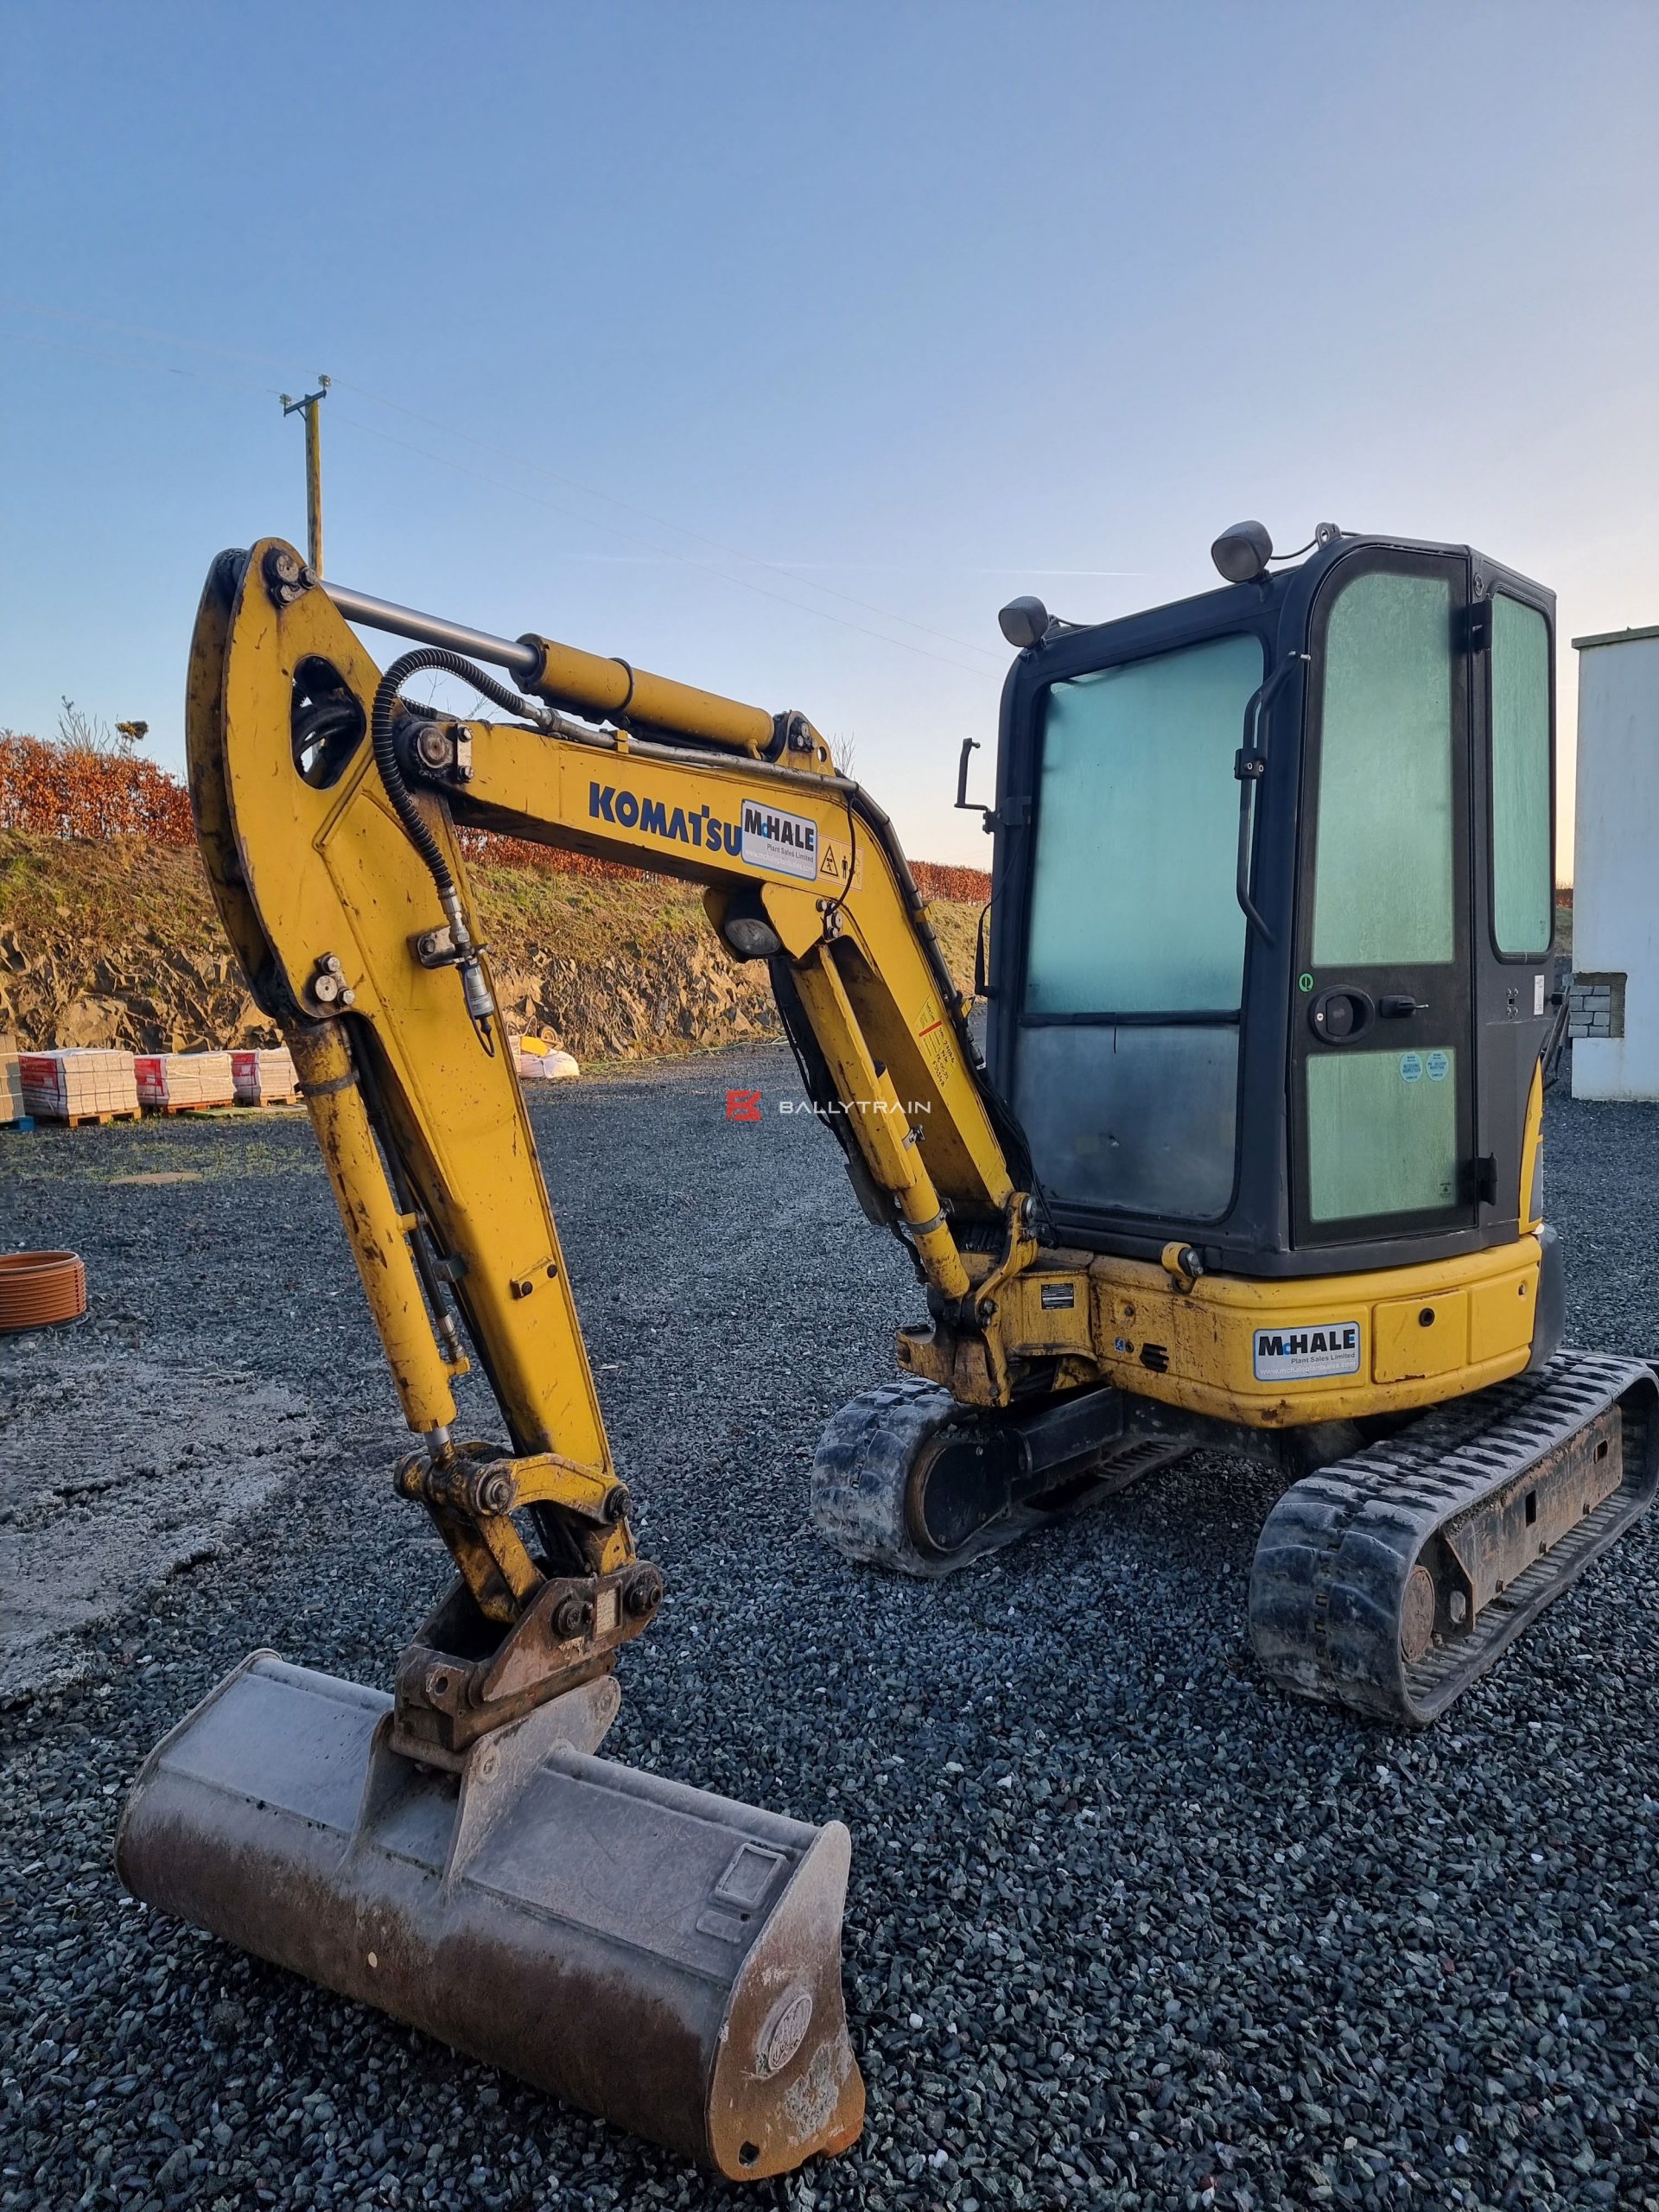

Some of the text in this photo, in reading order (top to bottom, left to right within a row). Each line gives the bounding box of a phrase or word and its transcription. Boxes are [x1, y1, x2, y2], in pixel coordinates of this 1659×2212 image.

[589, 781, 741, 856] KOMATSU
[744, 808, 814, 852] McHALE
[766, 843, 814, 863] Plant Sales Limited
[1258, 1328, 1356, 1357] McHALE
[1331, 1352, 1356, 1361] Limited
